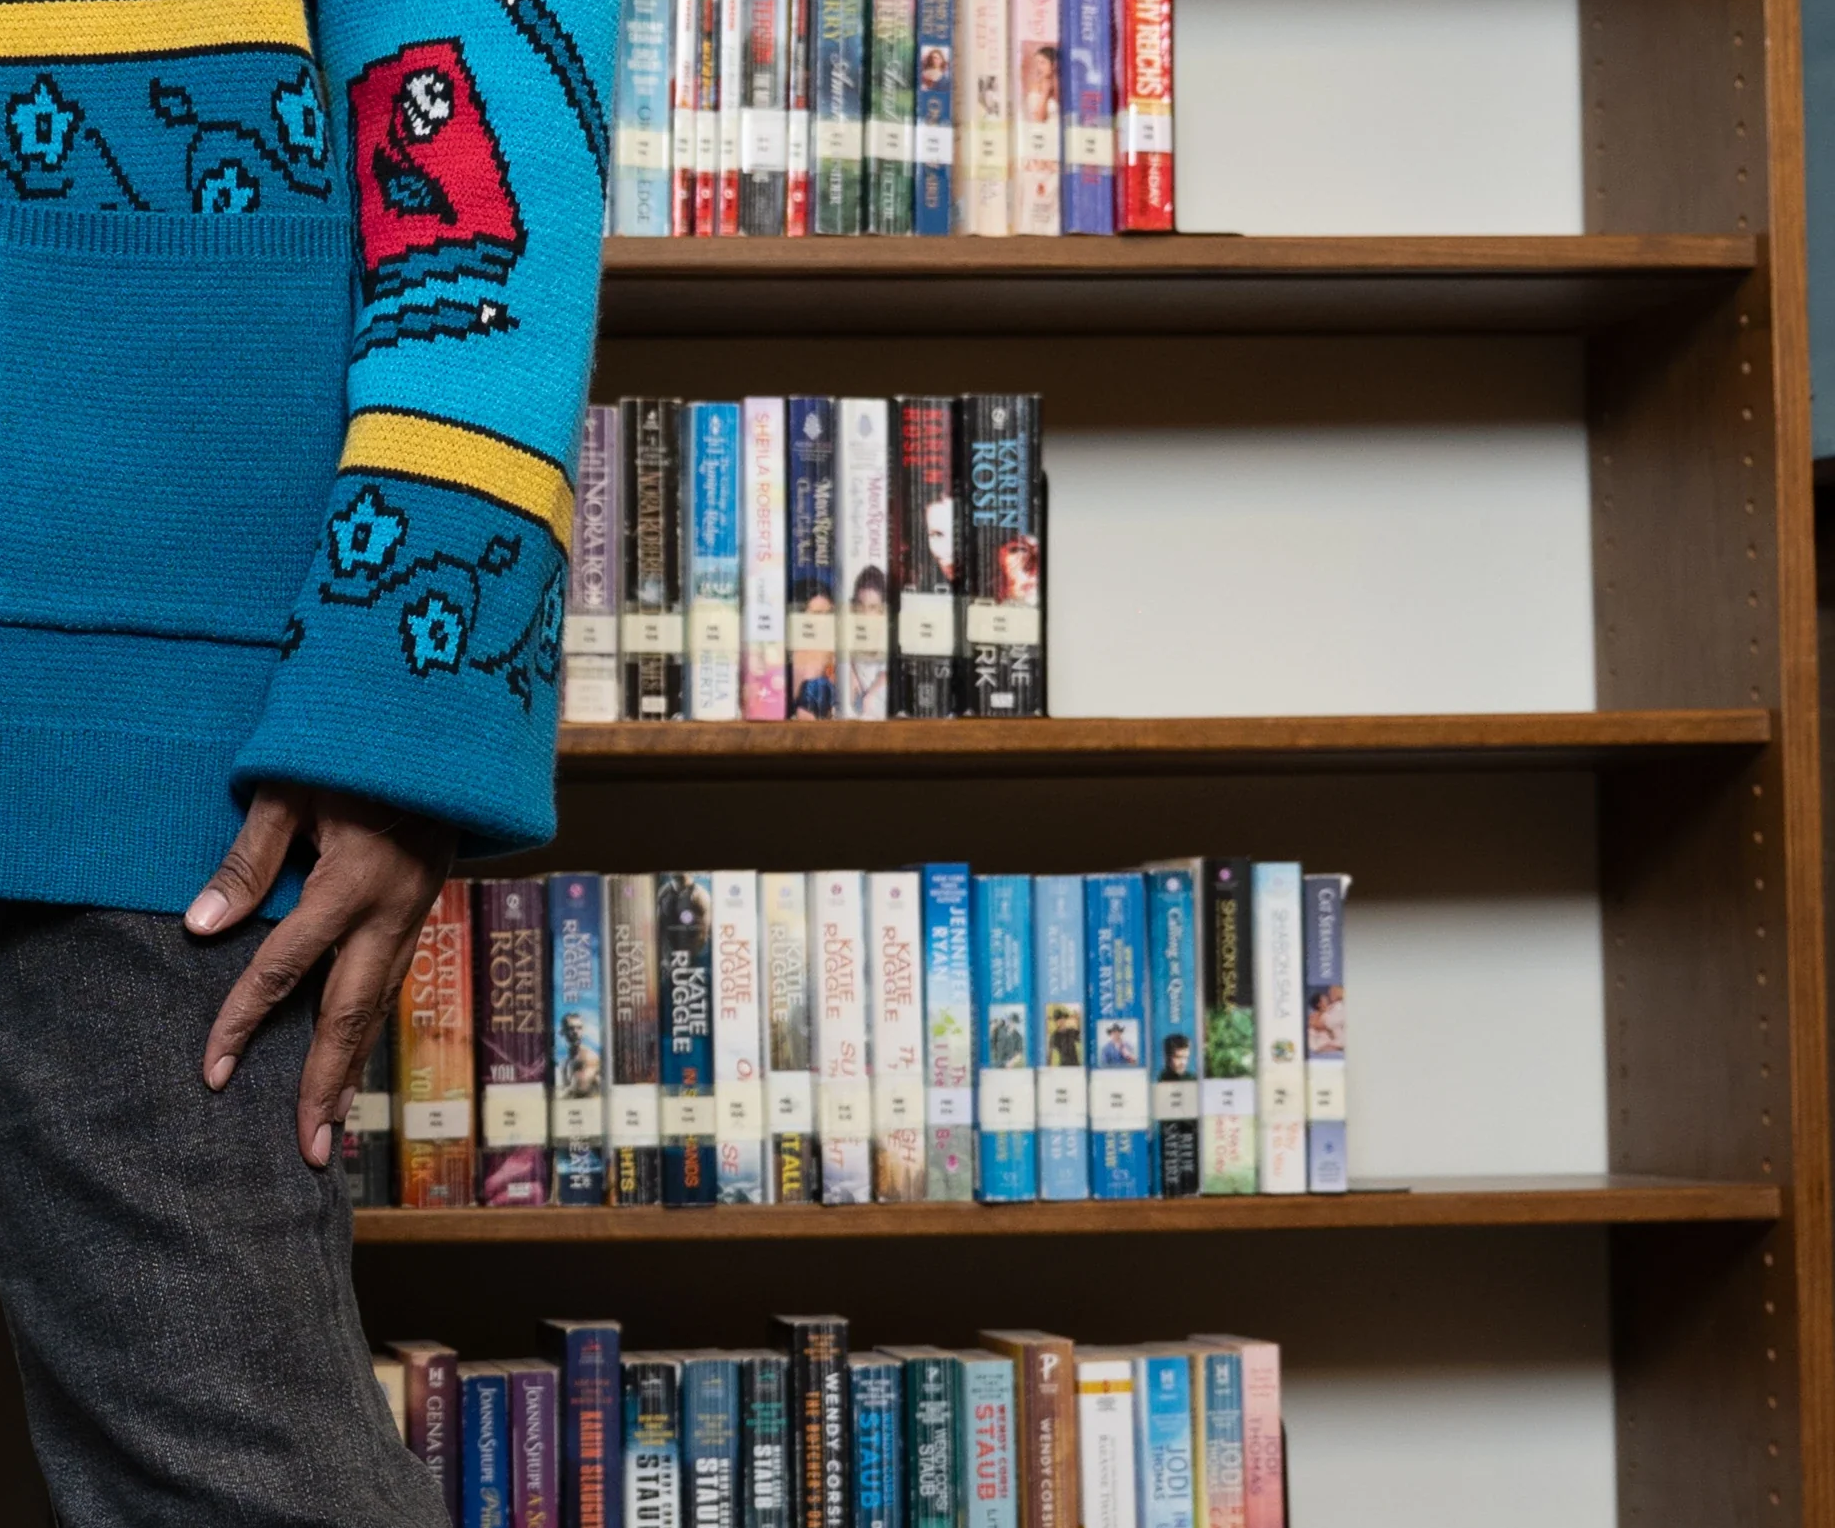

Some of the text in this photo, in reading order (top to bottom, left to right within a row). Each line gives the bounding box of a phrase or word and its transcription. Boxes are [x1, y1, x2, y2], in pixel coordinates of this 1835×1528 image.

[1136, 26, 1161, 96] REICHS
[754, 412, 772, 563] SHEILA ROBERTS
[971, 441, 996, 528] ROSE
[997, 438, 1018, 529] KAREN
[490, 930, 513, 1033] ROSE
[514, 928, 535, 1033] KAREN
[719, 924, 736, 1021] RUGGLE
[735, 940, 752, 1003] KATIE
[932, 927, 948, 981] RYAN
[949, 906, 967, 1002] JENNIFER
[426, 1395, 443, 1452] GENA
[579, 1410, 603, 1458] KARIN
[858, 1412, 882, 1510] STAUB
[1153, 1446, 1166, 1502] THOMAS
[1165, 1444, 1188, 1499] JODI
